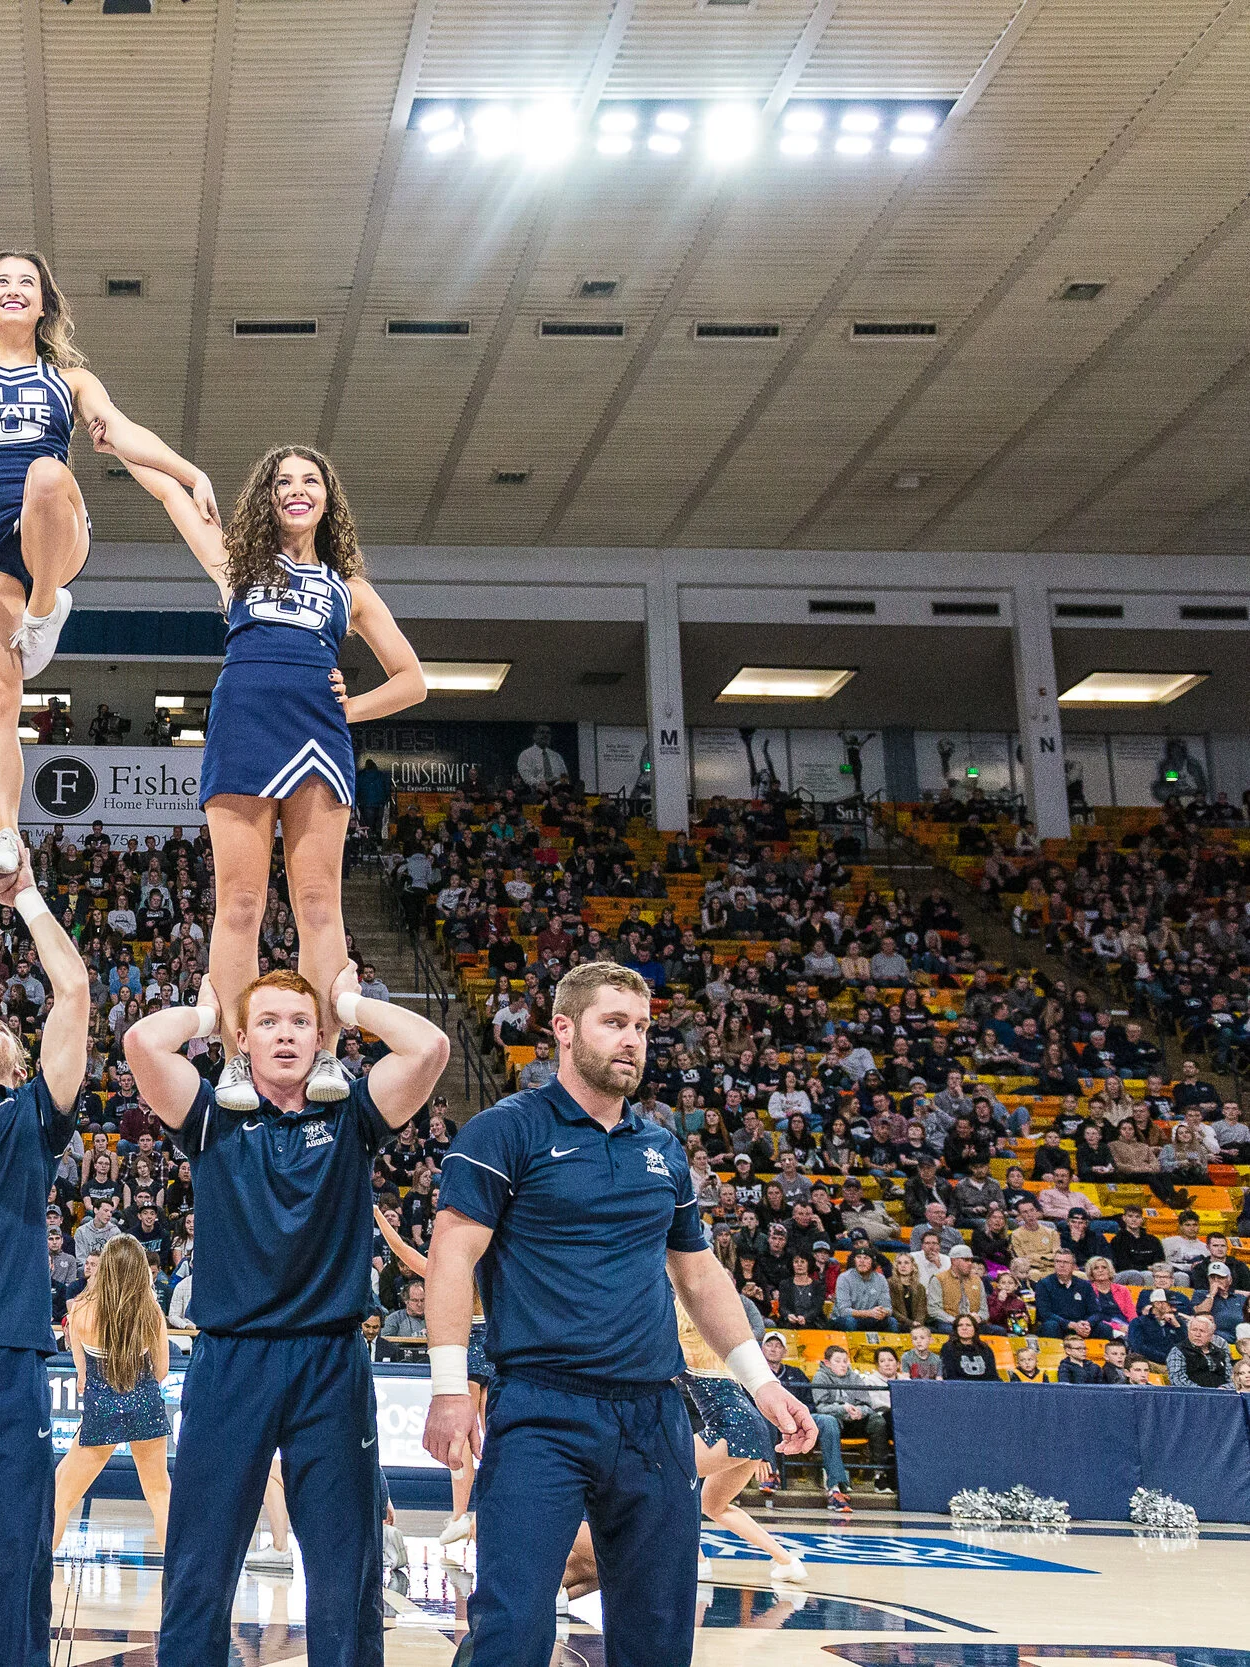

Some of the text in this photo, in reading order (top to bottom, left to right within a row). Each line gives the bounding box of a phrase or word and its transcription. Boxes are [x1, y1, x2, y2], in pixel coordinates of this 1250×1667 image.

[245, 584, 334, 619] STATE
[660, 729, 679, 746] M
[1040, 736, 1056, 753] N
[51, 770, 79, 804] F
[109, 764, 200, 796] Fishe
[103, 796, 200, 811] Home Furnishi
[305, 1134, 334, 1148] AGGIES
